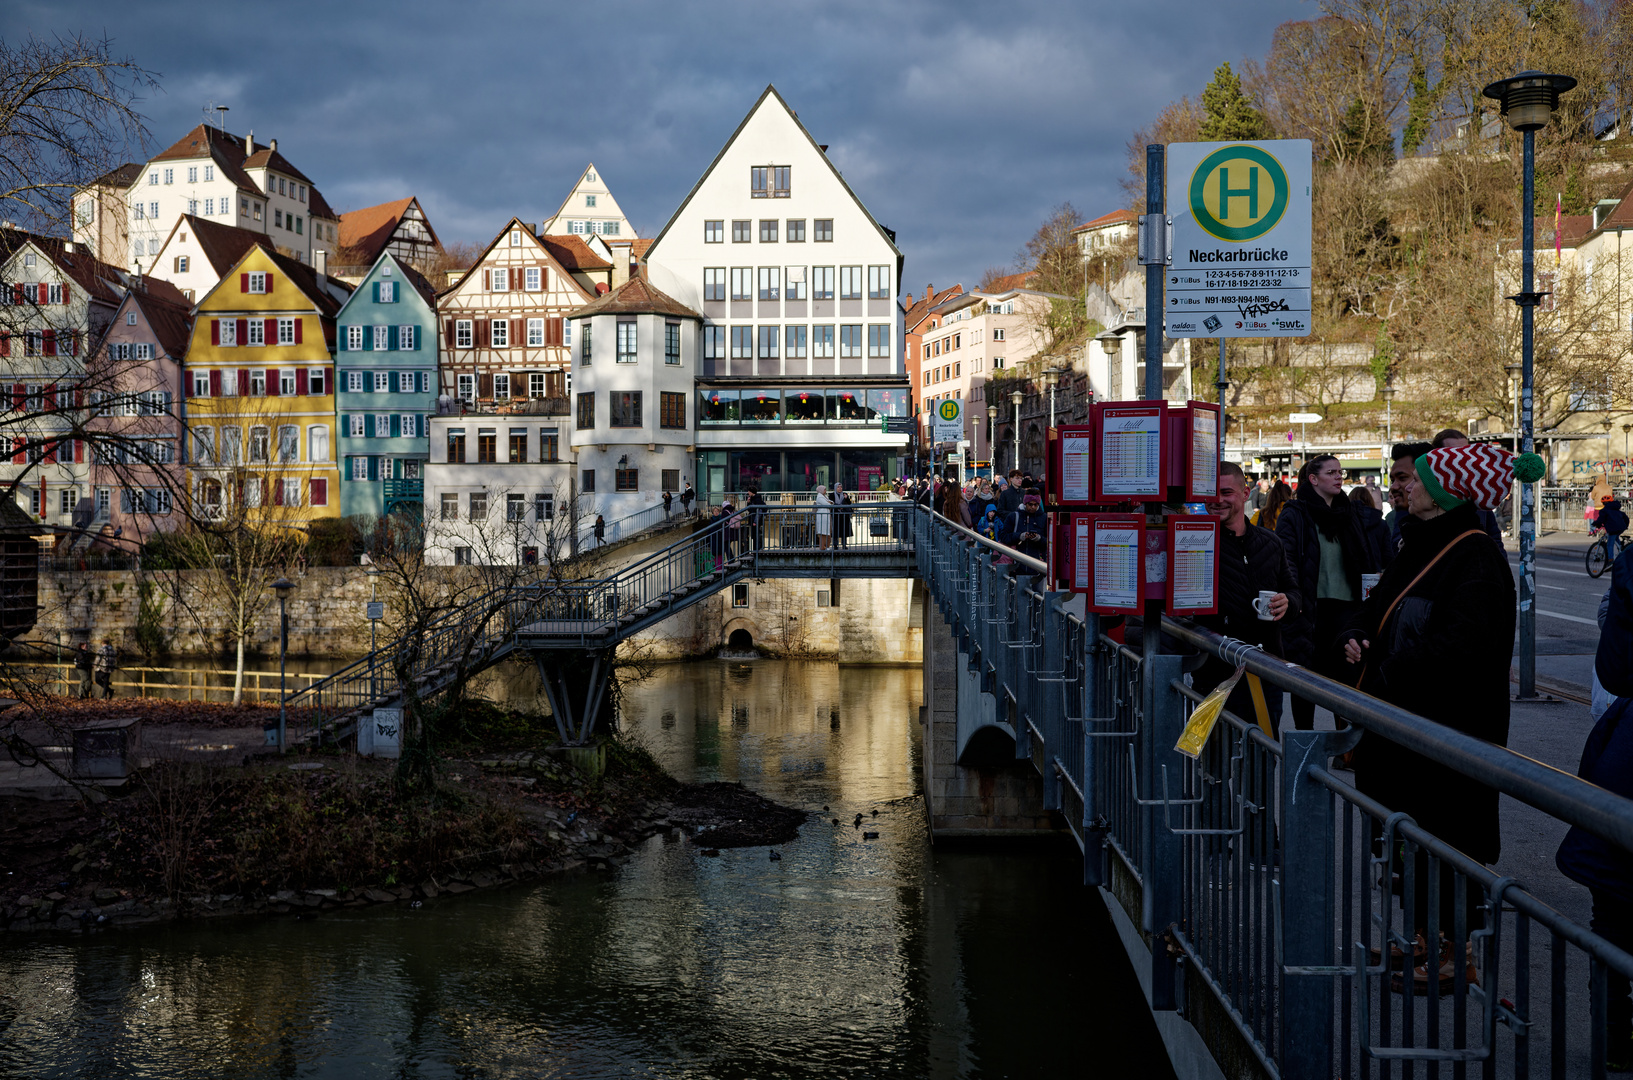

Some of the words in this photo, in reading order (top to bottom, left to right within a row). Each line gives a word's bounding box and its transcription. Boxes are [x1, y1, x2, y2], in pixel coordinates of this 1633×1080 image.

[1219, 166, 1259, 220] H
[1189, 247, 1289, 263] Neckarbrücke
[945, 404, 954, 416] H
